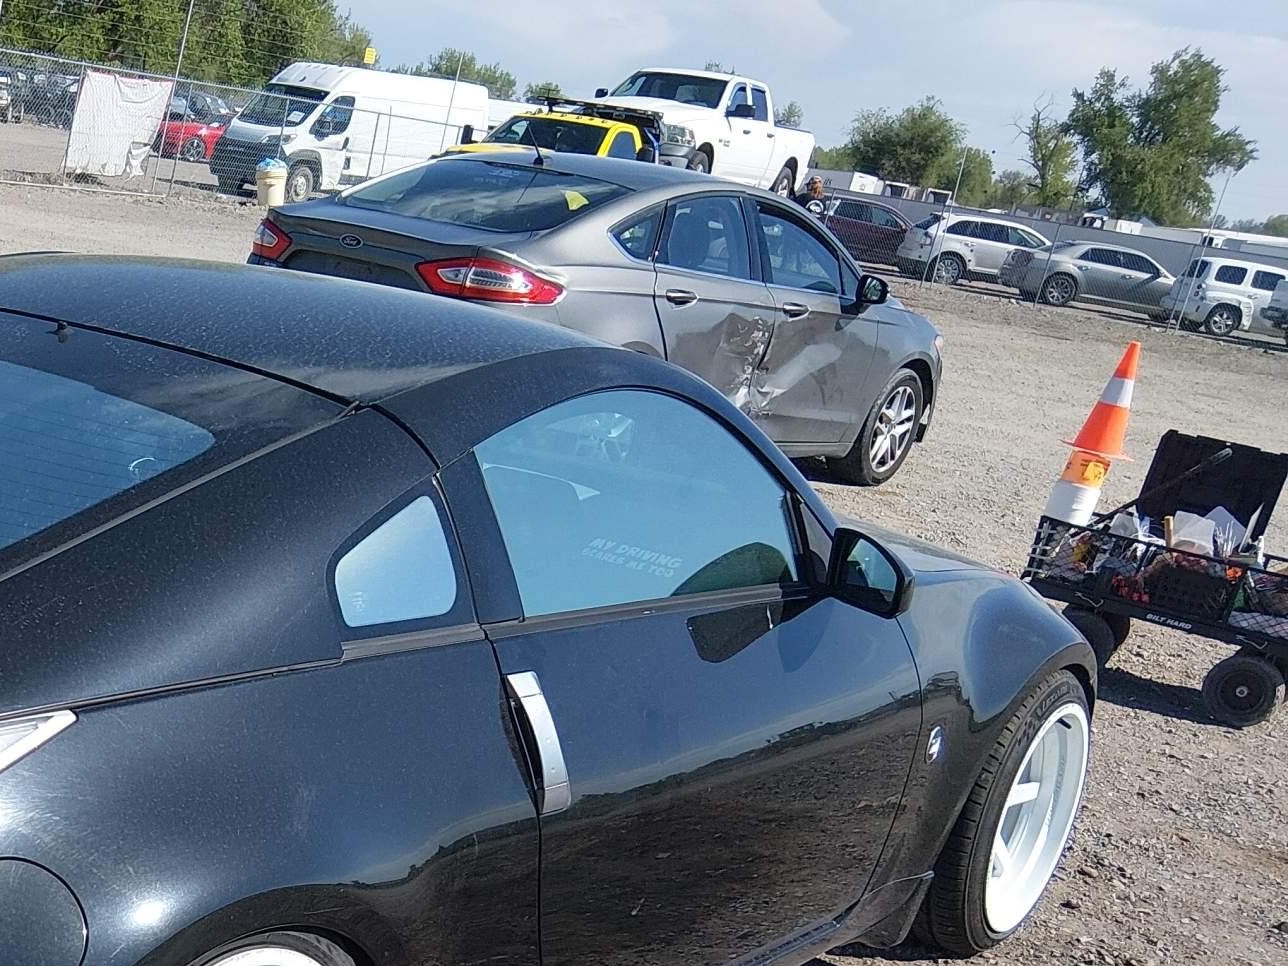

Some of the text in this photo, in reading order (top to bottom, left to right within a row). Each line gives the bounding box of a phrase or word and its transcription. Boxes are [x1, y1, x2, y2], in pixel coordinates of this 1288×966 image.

[588, 537, 681, 568] MY DRIVING
[1145, 613, 1193, 630] BILT HARD
